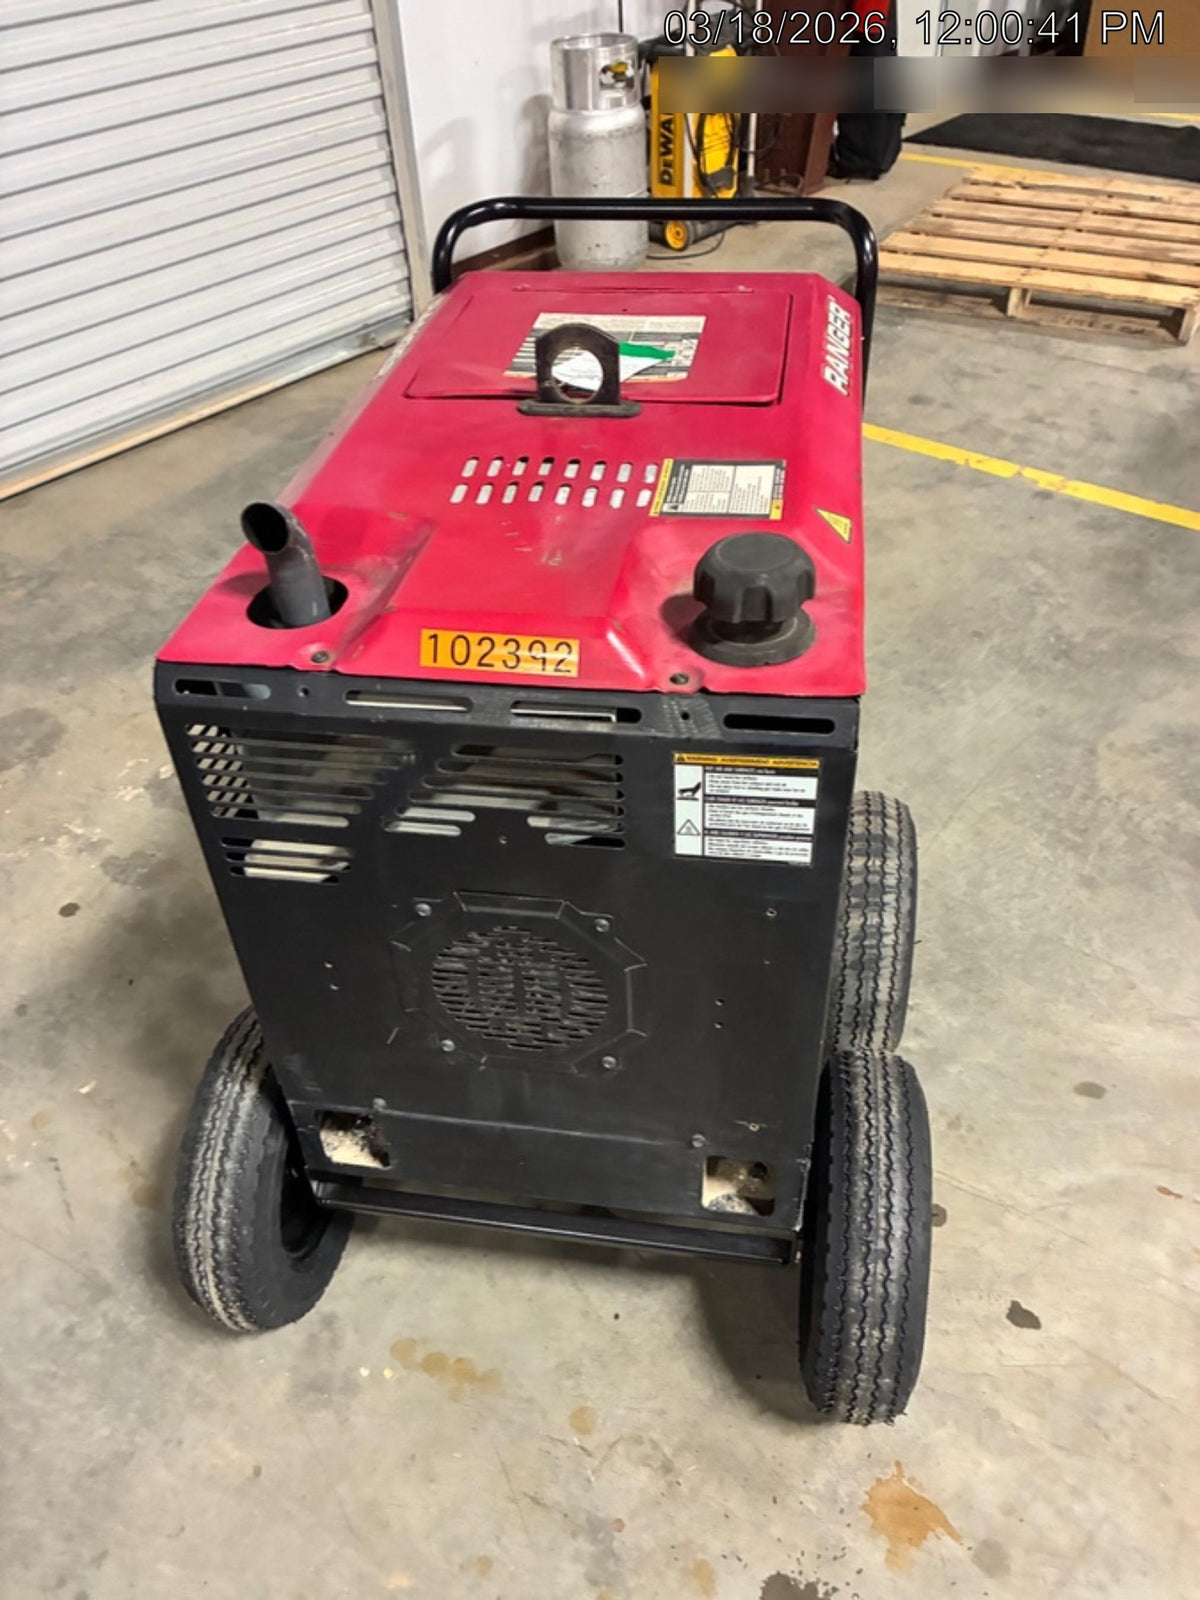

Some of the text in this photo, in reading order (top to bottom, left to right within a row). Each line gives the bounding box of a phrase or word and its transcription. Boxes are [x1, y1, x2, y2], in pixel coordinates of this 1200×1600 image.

[658, 113, 675, 186] DEWA
[823, 297, 852, 397] RANGER
[427, 632, 574, 674] 102392
